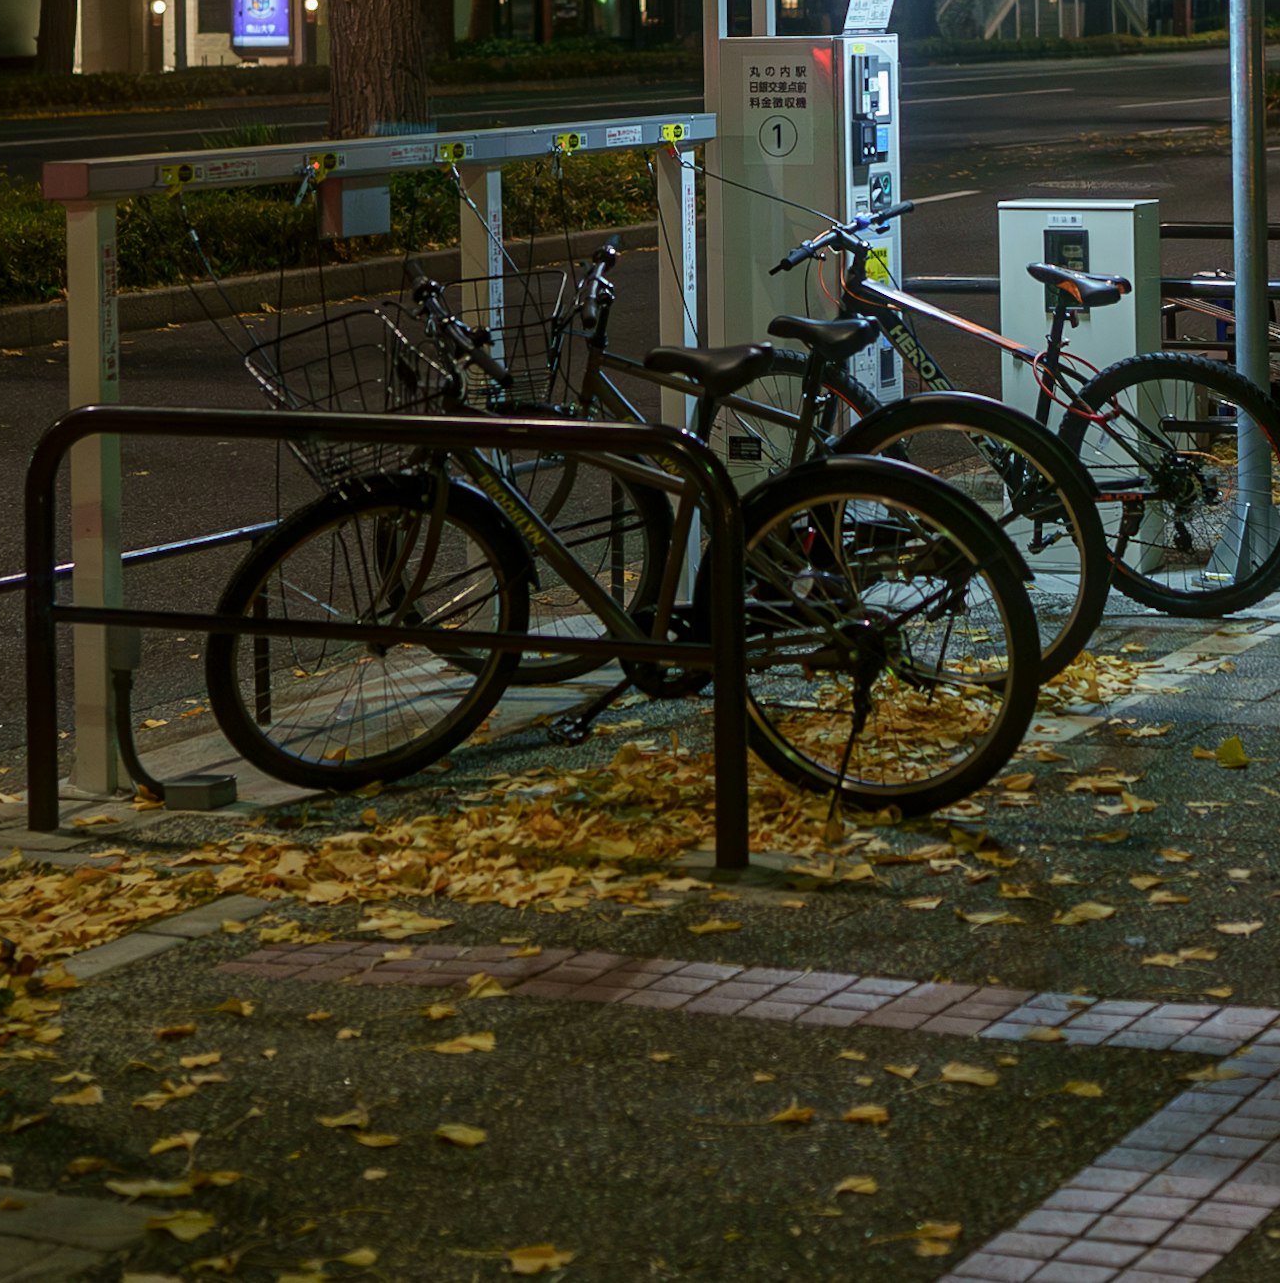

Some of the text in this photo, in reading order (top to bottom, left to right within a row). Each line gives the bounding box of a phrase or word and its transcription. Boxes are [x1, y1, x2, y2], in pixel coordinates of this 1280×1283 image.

[749, 66, 807, 78] 丸の内駅
[749, 81, 807, 93] 日銀交差点前
[749, 97, 807, 109] 料金徴収機
[479, 473, 546, 545] BROOKLYN
